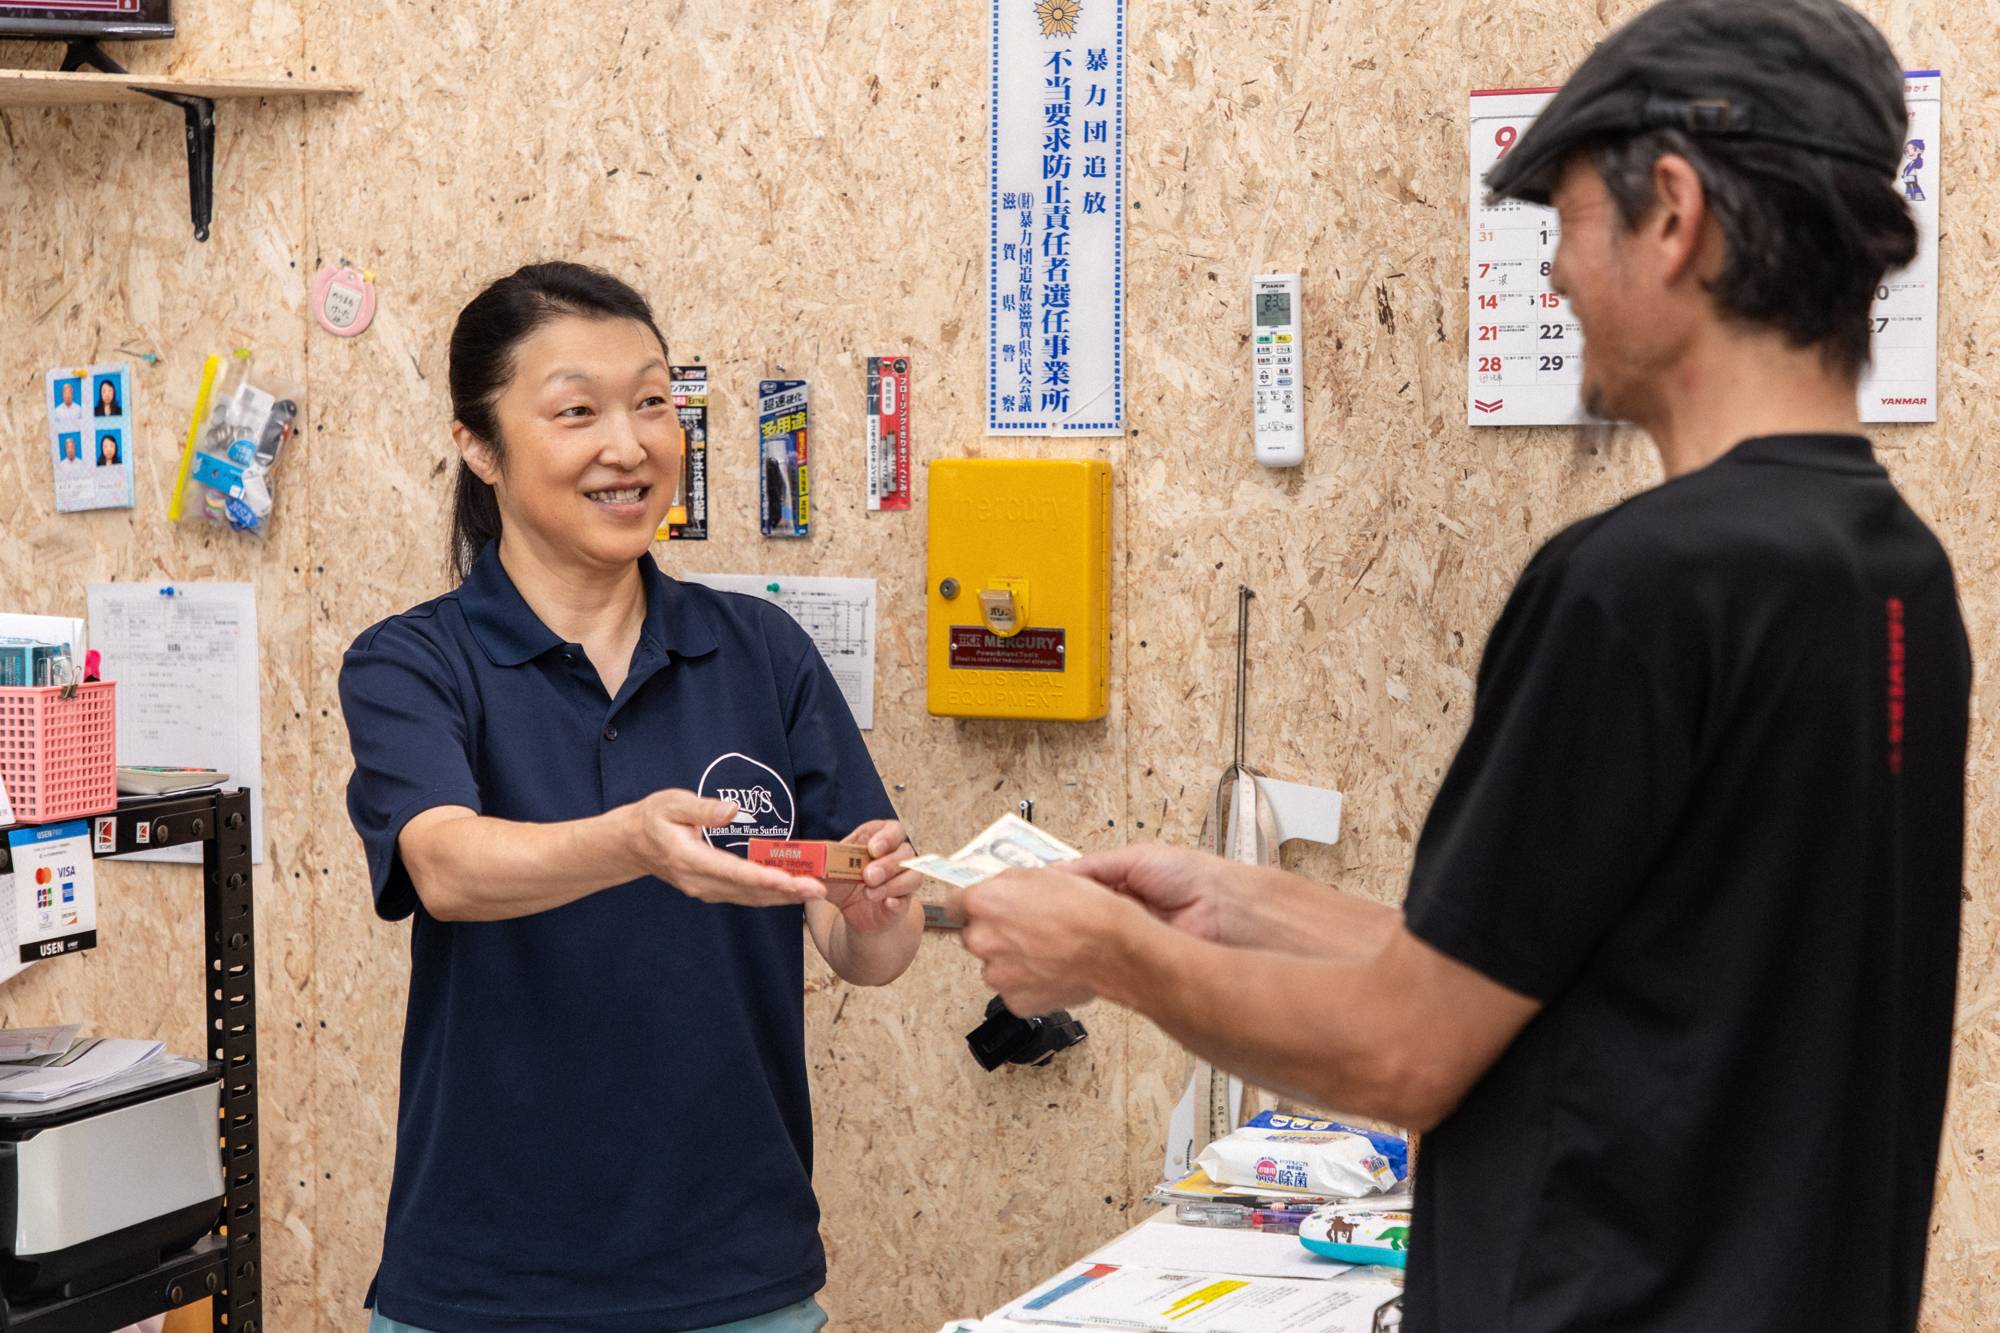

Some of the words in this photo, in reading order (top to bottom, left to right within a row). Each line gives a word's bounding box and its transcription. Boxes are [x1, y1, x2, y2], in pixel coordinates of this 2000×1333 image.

[1082, 48, 1108, 214] 暴力団追放
[1495, 126, 1518, 159] 9
[1041, 49, 1072, 413] 不当要求防止責任者選任事業所
[1479, 232, 1493, 241] 31
[1540, 230, 1547, 245] 1
[1478, 263, 1490, 278] 7
[1540, 261, 1551, 276] 8
[1540, 293, 1560, 308] 15
[1875, 285, 1889, 301] 0
[1478, 294, 1498, 309] 14
[1478, 326, 1497, 340] 21
[1540, 324, 1564, 339] 22
[1478, 356, 1502, 372] 28
[1539, 355, 1564, 371] 29
[672, 385, 704, 393] ンアルフア
[762, 412, 806, 438] 多用途
[984, 636, 1057, 649] MERCURY
[760, 826, 788, 834] Surfing
[769, 848, 802, 858] WARM
[58, 866, 76, 878] VISA
[40, 941, 64, 956] USEN
[1279, 1170, 1308, 1188] 除菌
